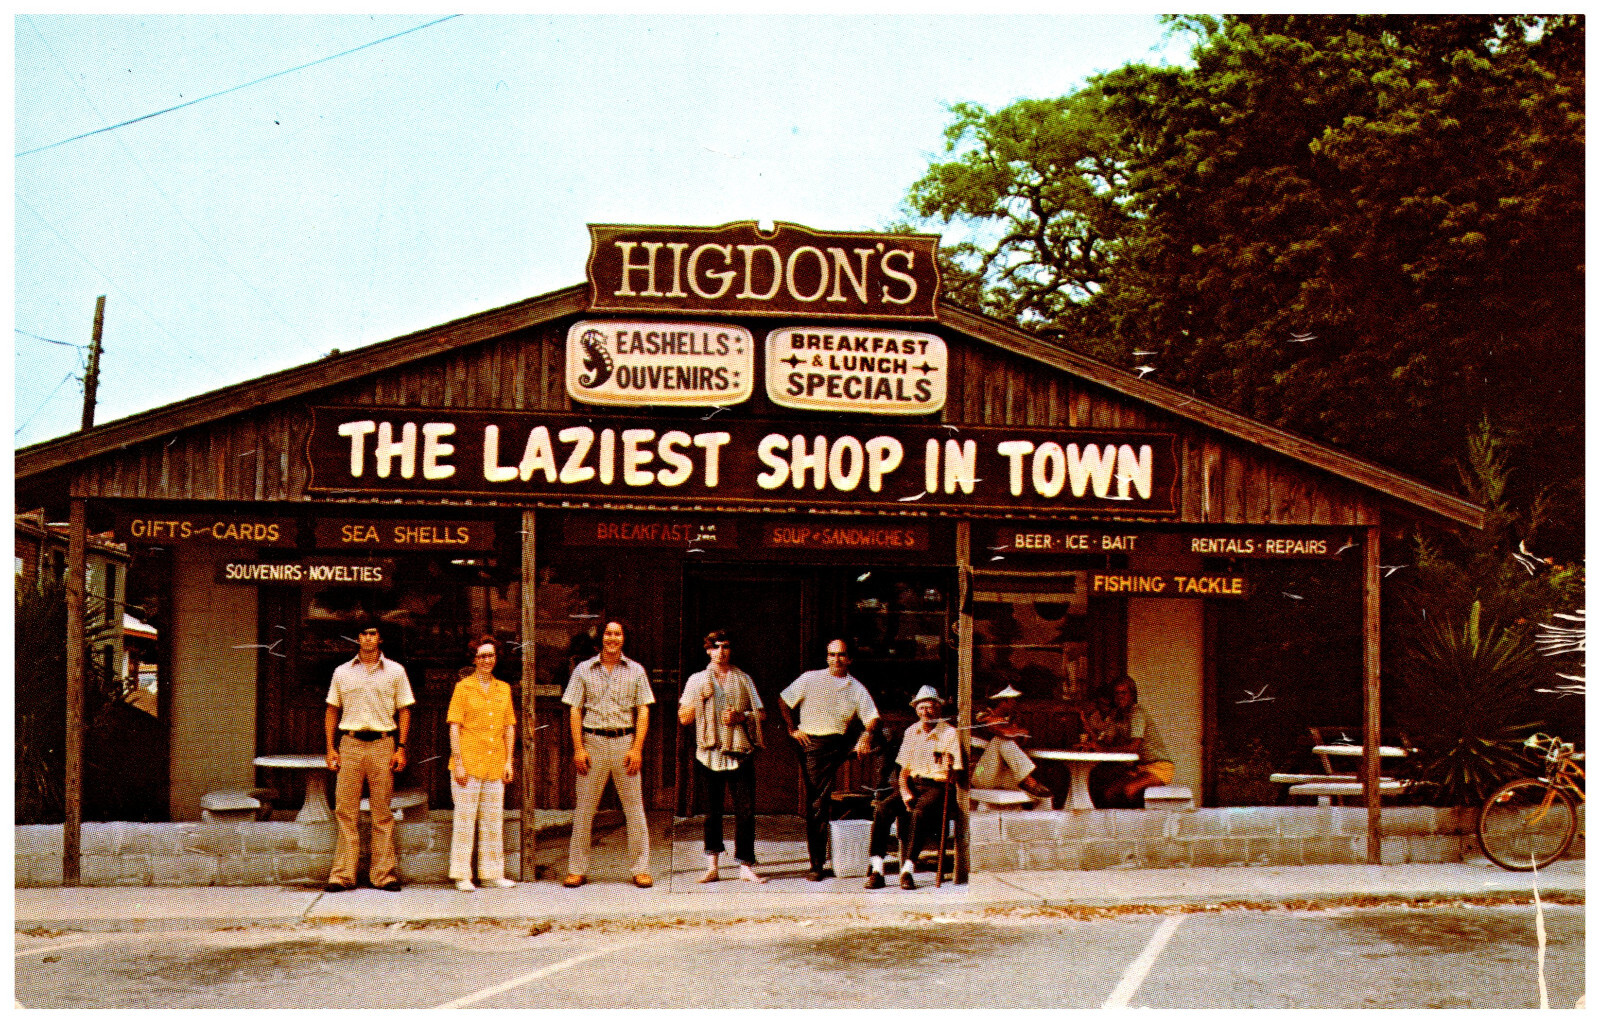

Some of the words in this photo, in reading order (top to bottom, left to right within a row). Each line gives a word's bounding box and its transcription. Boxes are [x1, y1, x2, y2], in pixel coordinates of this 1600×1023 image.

[614, 242, 918, 304] HIGDON'S
[791, 332, 929, 355] BREAKFAST
[812, 355, 823, 367] &
[830, 356, 908, 374] LUNCH
[786, 372, 932, 403] SPECIALS
[338, 420, 456, 480] THE
[483, 424, 731, 487] LAZIEST
[757, 434, 904, 493] SHOP
[925, 438, 977, 495] IN
[997, 440, 1154, 499] TOWN
[131, 519, 192, 538] GIFTS
[212, 521, 280, 541] CARDS
[341, 525, 380, 543] SEA
[394, 526, 470, 544] SHELLS
[597, 523, 692, 540] BREAKFAST
[773, 528, 811, 543] SOUP
[822, 528, 915, 546] SANDWICHES
[1014, 533, 1052, 549] BEER
[1065, 535, 1088, 550] ICE
[1102, 535, 1138, 551] BAIT
[1191, 538, 1255, 554] RENTALS
[1265, 539, 1327, 555] REPAIRS
[225, 564, 302, 580] SOUVENIRS
[308, 565, 383, 583] NOVELTIES
[1093, 575, 1166, 593] FISHING
[1174, 577, 1243, 596] TACKLE
